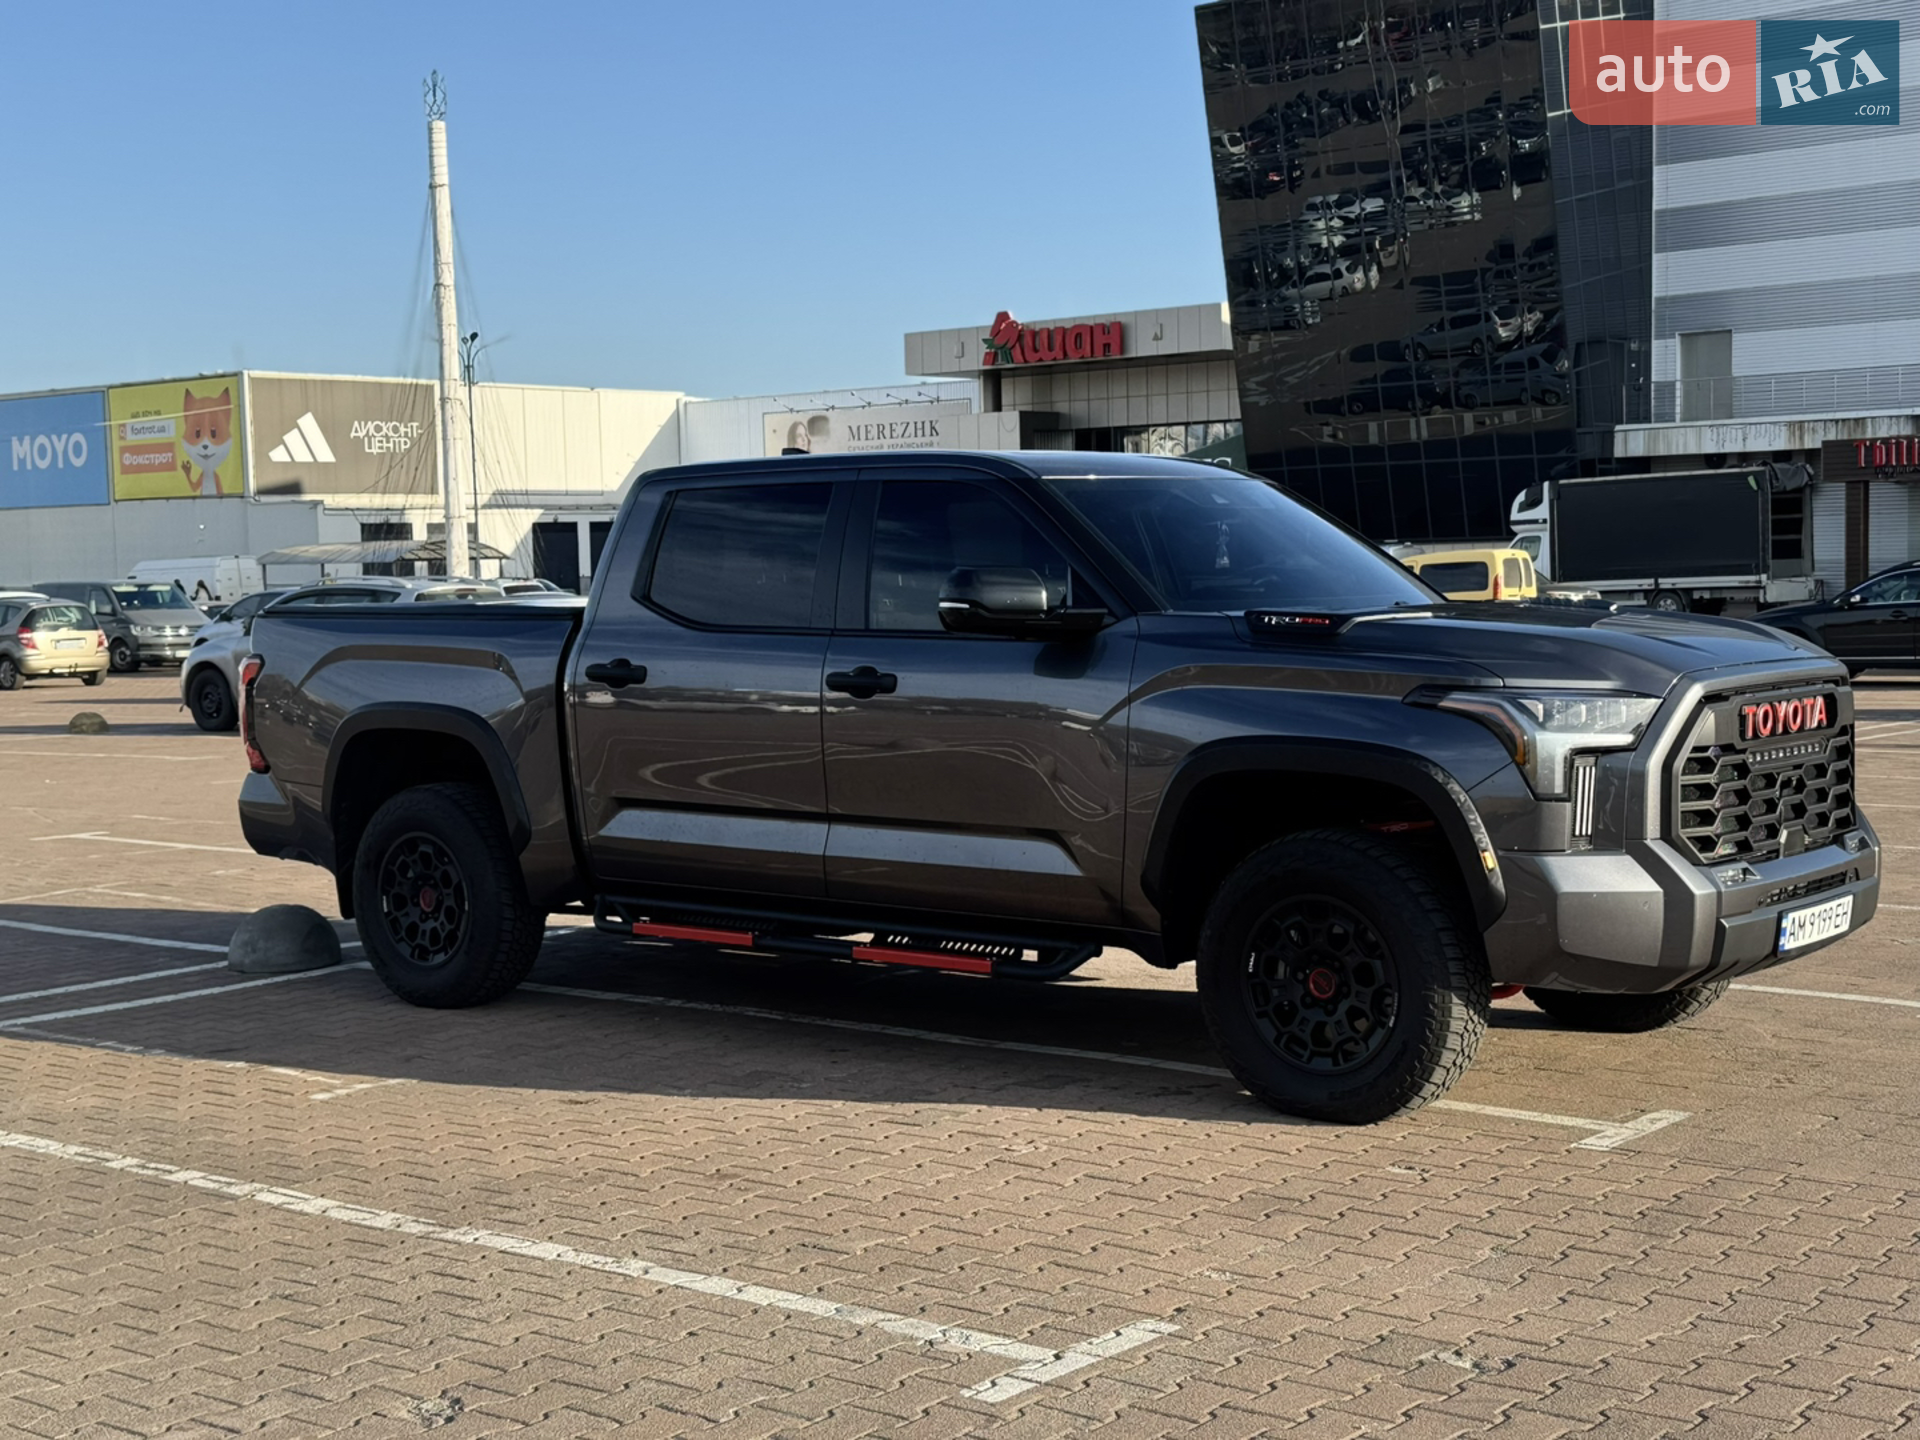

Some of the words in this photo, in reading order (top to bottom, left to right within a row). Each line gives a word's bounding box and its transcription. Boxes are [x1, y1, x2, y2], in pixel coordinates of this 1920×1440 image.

[11, 432, 88, 471] MOYO
[122, 452, 174, 466] Фокстрот
[364, 436, 411, 455] ЦЕНТР
[1742, 695, 1827, 739] TOYOTA
